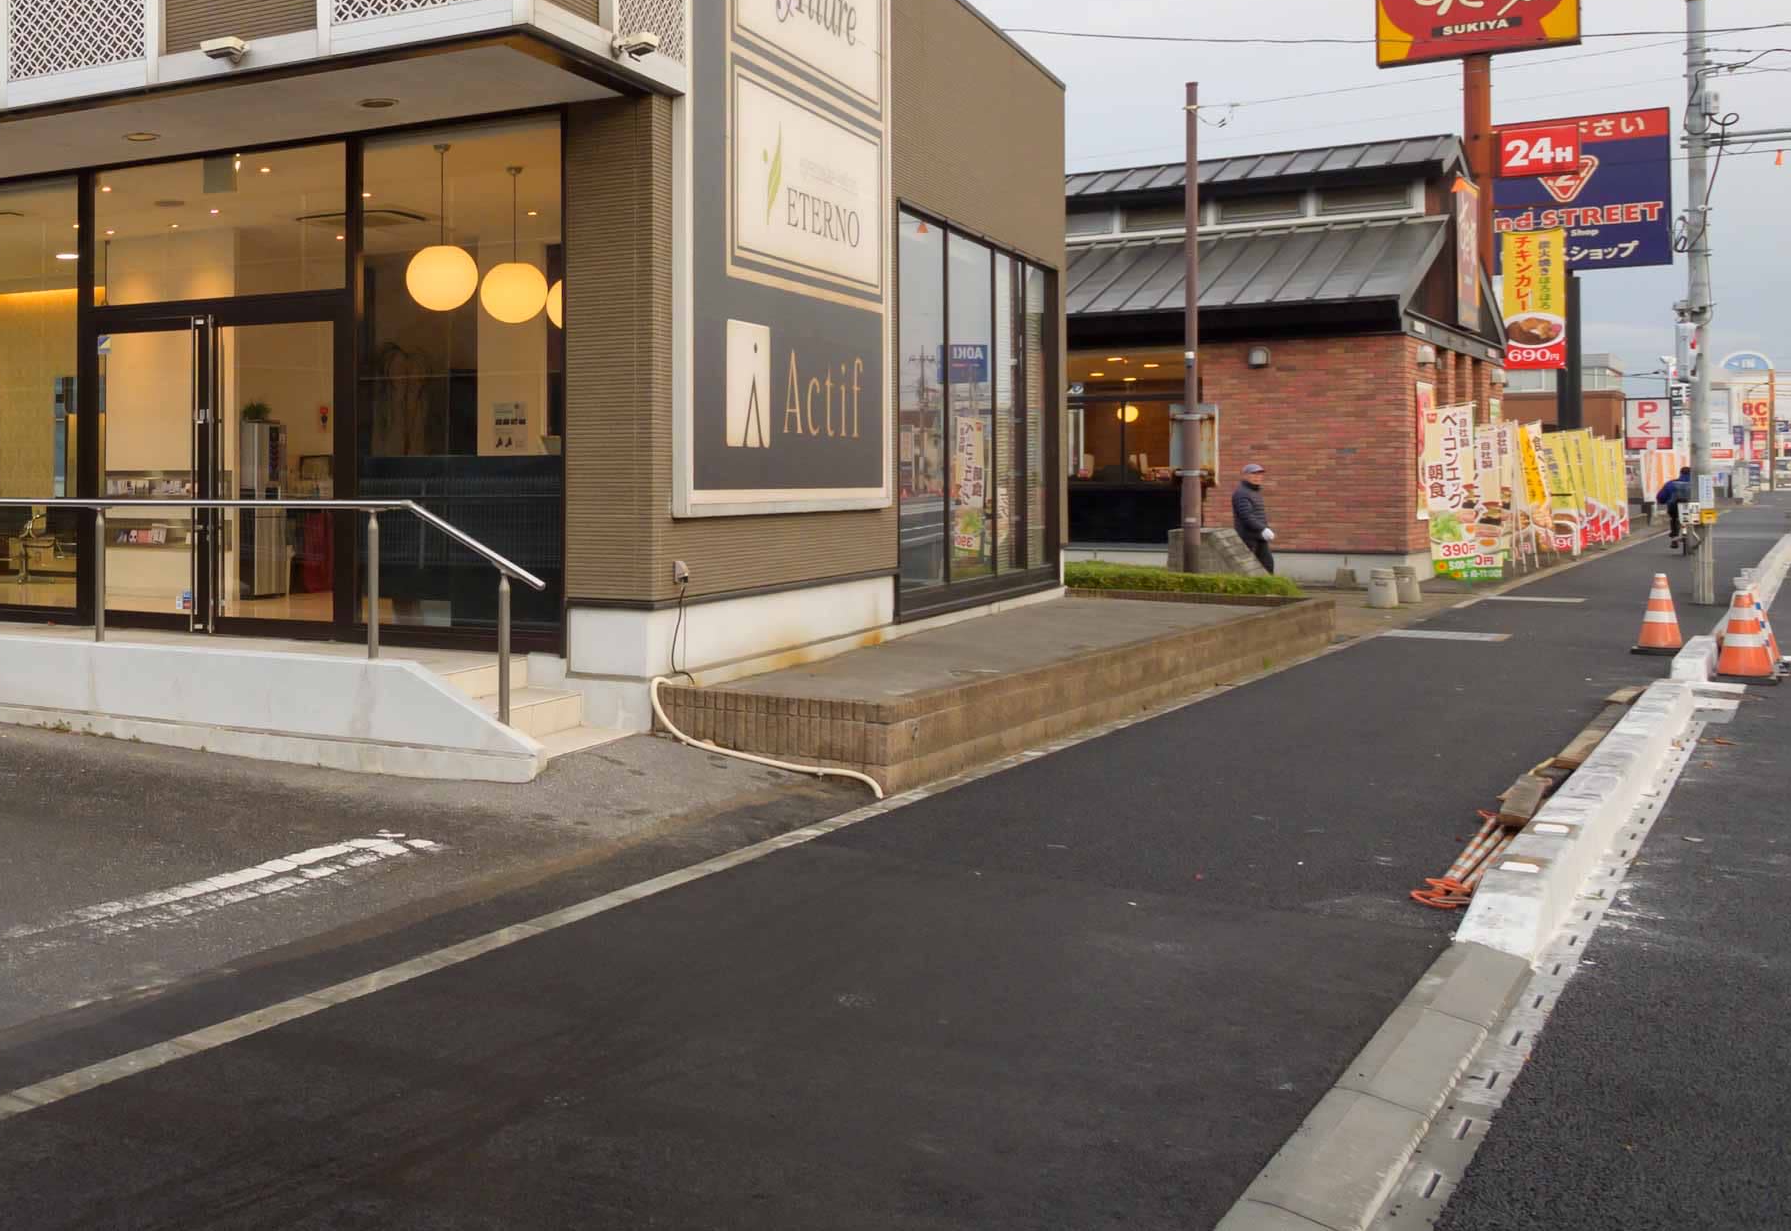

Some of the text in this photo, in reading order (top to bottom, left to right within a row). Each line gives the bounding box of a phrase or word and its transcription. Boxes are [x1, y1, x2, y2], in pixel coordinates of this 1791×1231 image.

[1442, 18, 1510, 36] SUKIYA
[1504, 136, 1574, 168] 24H
[786, 186, 860, 248] ETERNO
[1540, 201, 1664, 229] STREET
[1570, 227, 1600, 238] Shop
[1514, 235, 1533, 312] チキンカレー
[1508, 349, 1561, 363] 690円
[783, 348, 864, 438] Actif
[1637, 401, 1658, 419] P
[1441, 413, 1462, 509] ベーコンエッグ
[1427, 464, 1447, 499] 朝食
